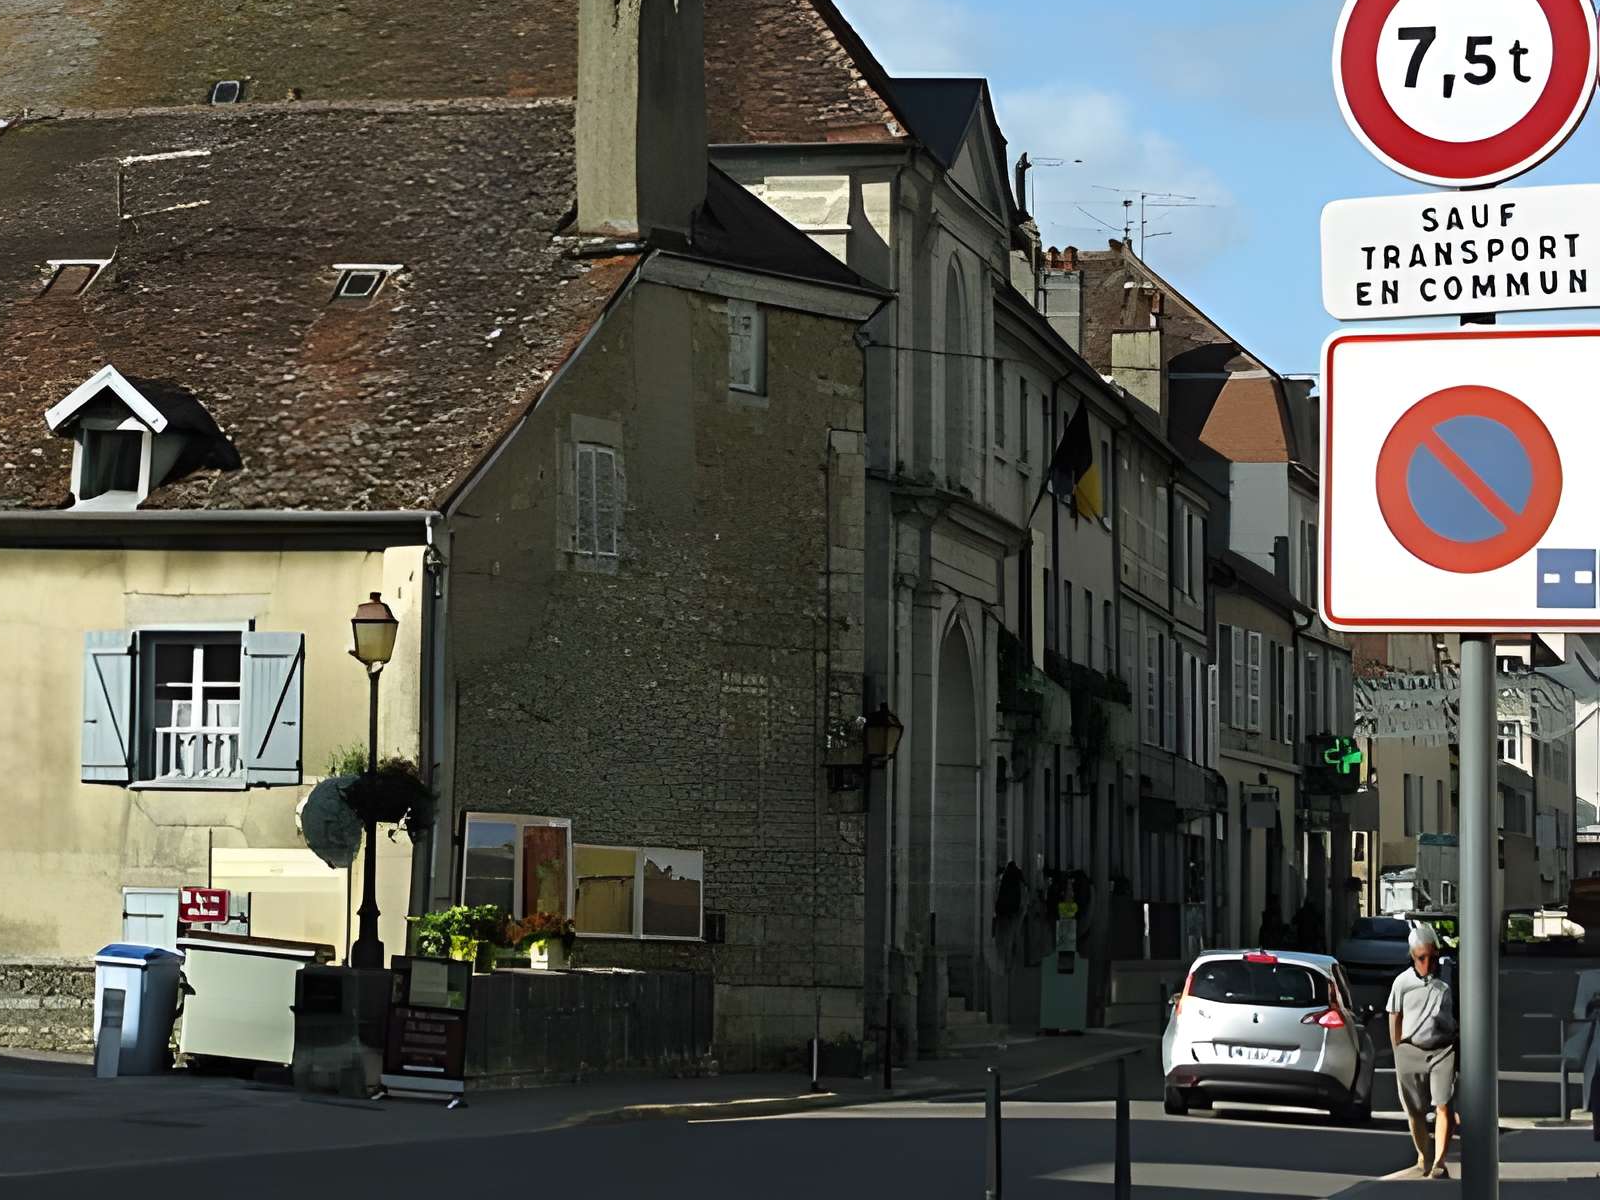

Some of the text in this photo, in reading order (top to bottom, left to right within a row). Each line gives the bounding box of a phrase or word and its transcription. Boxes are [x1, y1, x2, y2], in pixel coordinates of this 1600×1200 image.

[1421, 202, 1516, 233] SAUF
[1360, 233, 1581, 271] TRANSPORT
[1356, 269, 1588, 306] EN COMMUN
